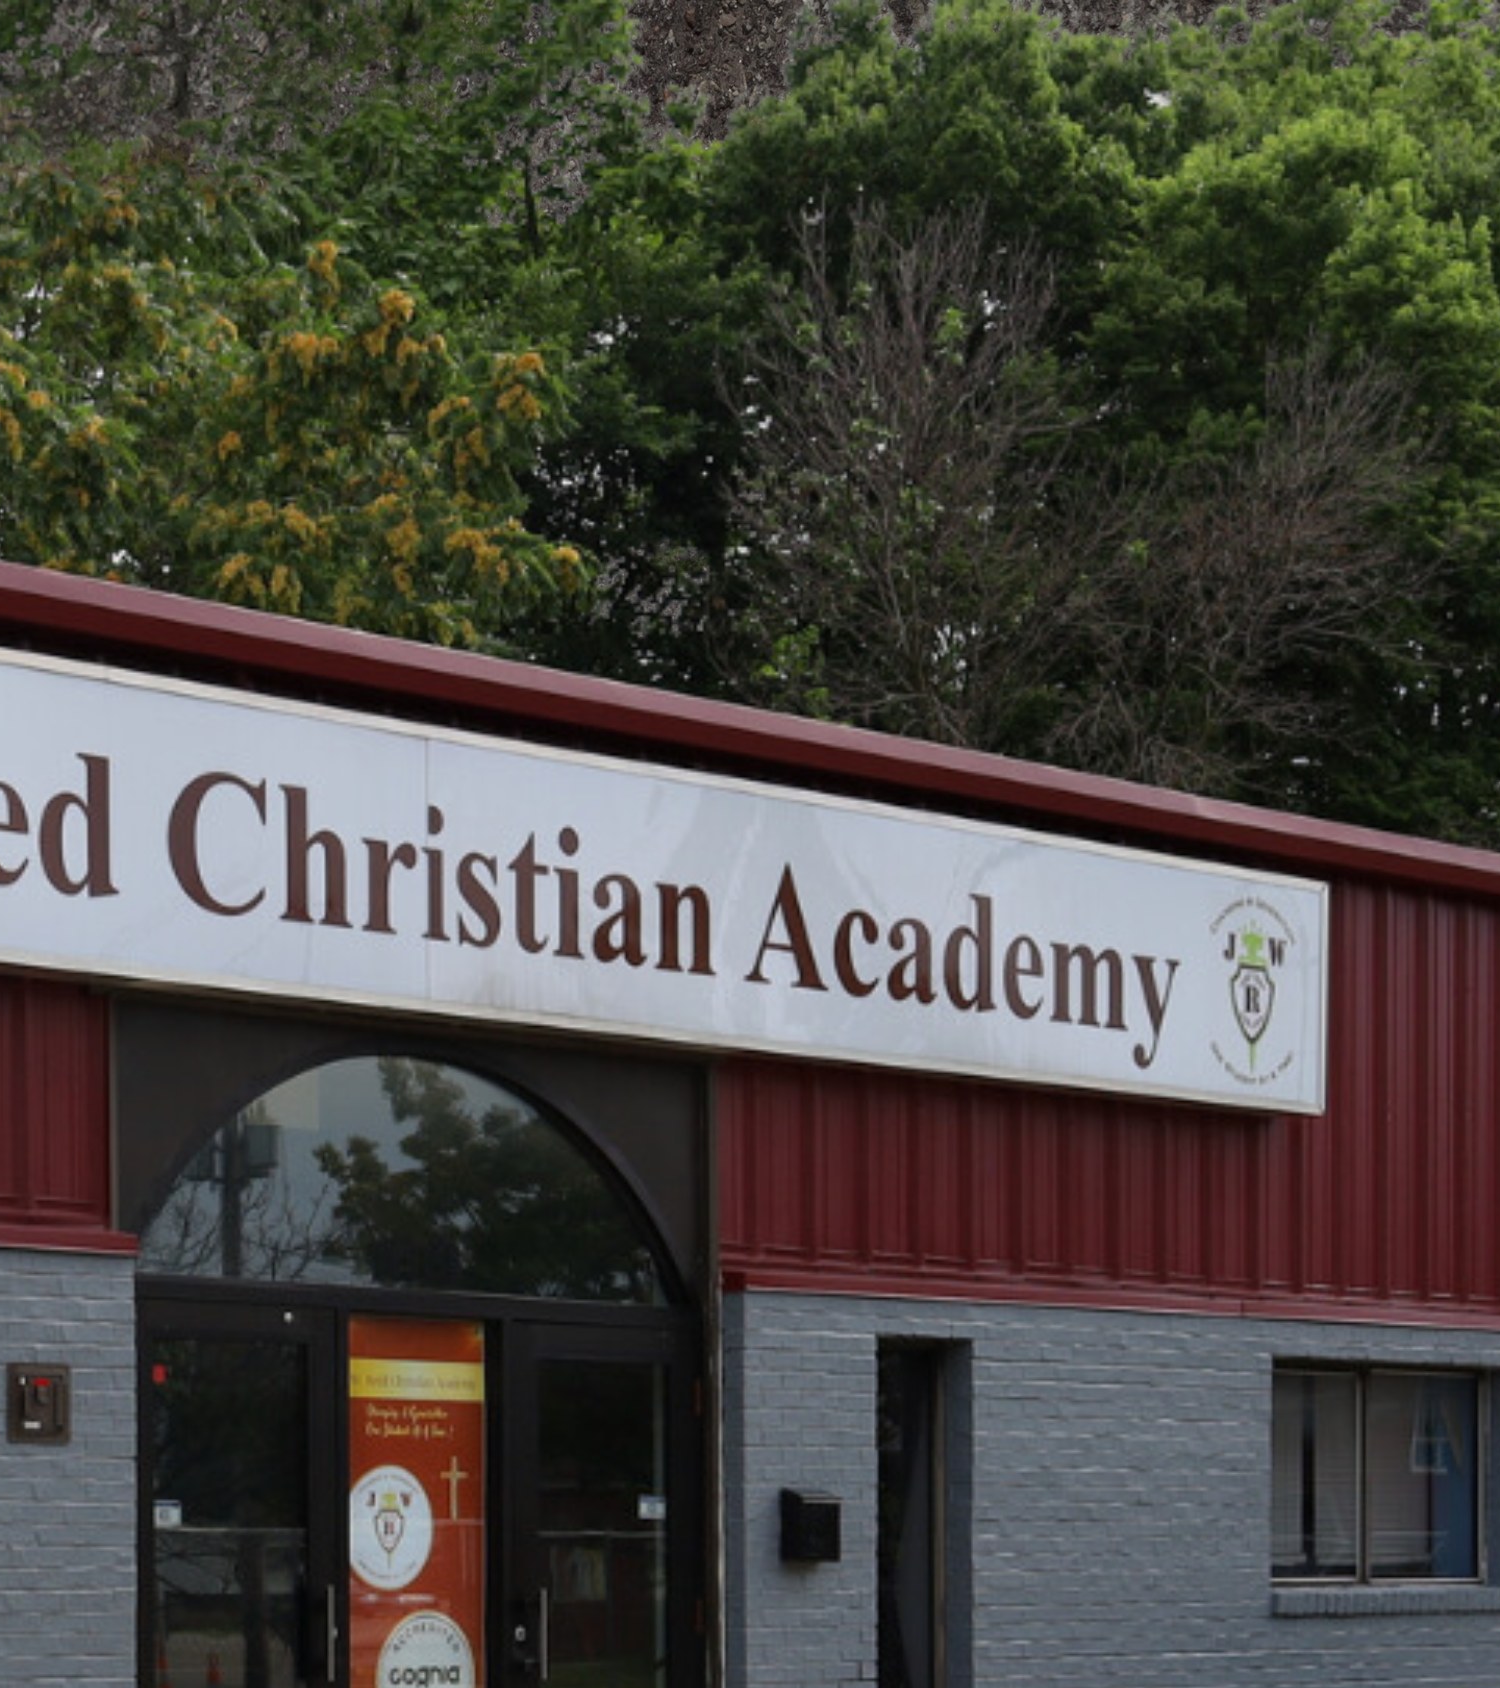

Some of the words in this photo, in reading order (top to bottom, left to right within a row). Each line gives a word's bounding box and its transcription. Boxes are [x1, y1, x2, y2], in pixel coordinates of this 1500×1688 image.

[166, 770, 718, 977] Christian
[743, 862, 1181, 1069] Academy
[1223, 933, 1236, 961] J
[1245, 984, 1261, 1014] R
[389, 1665, 461, 1688] cognia
